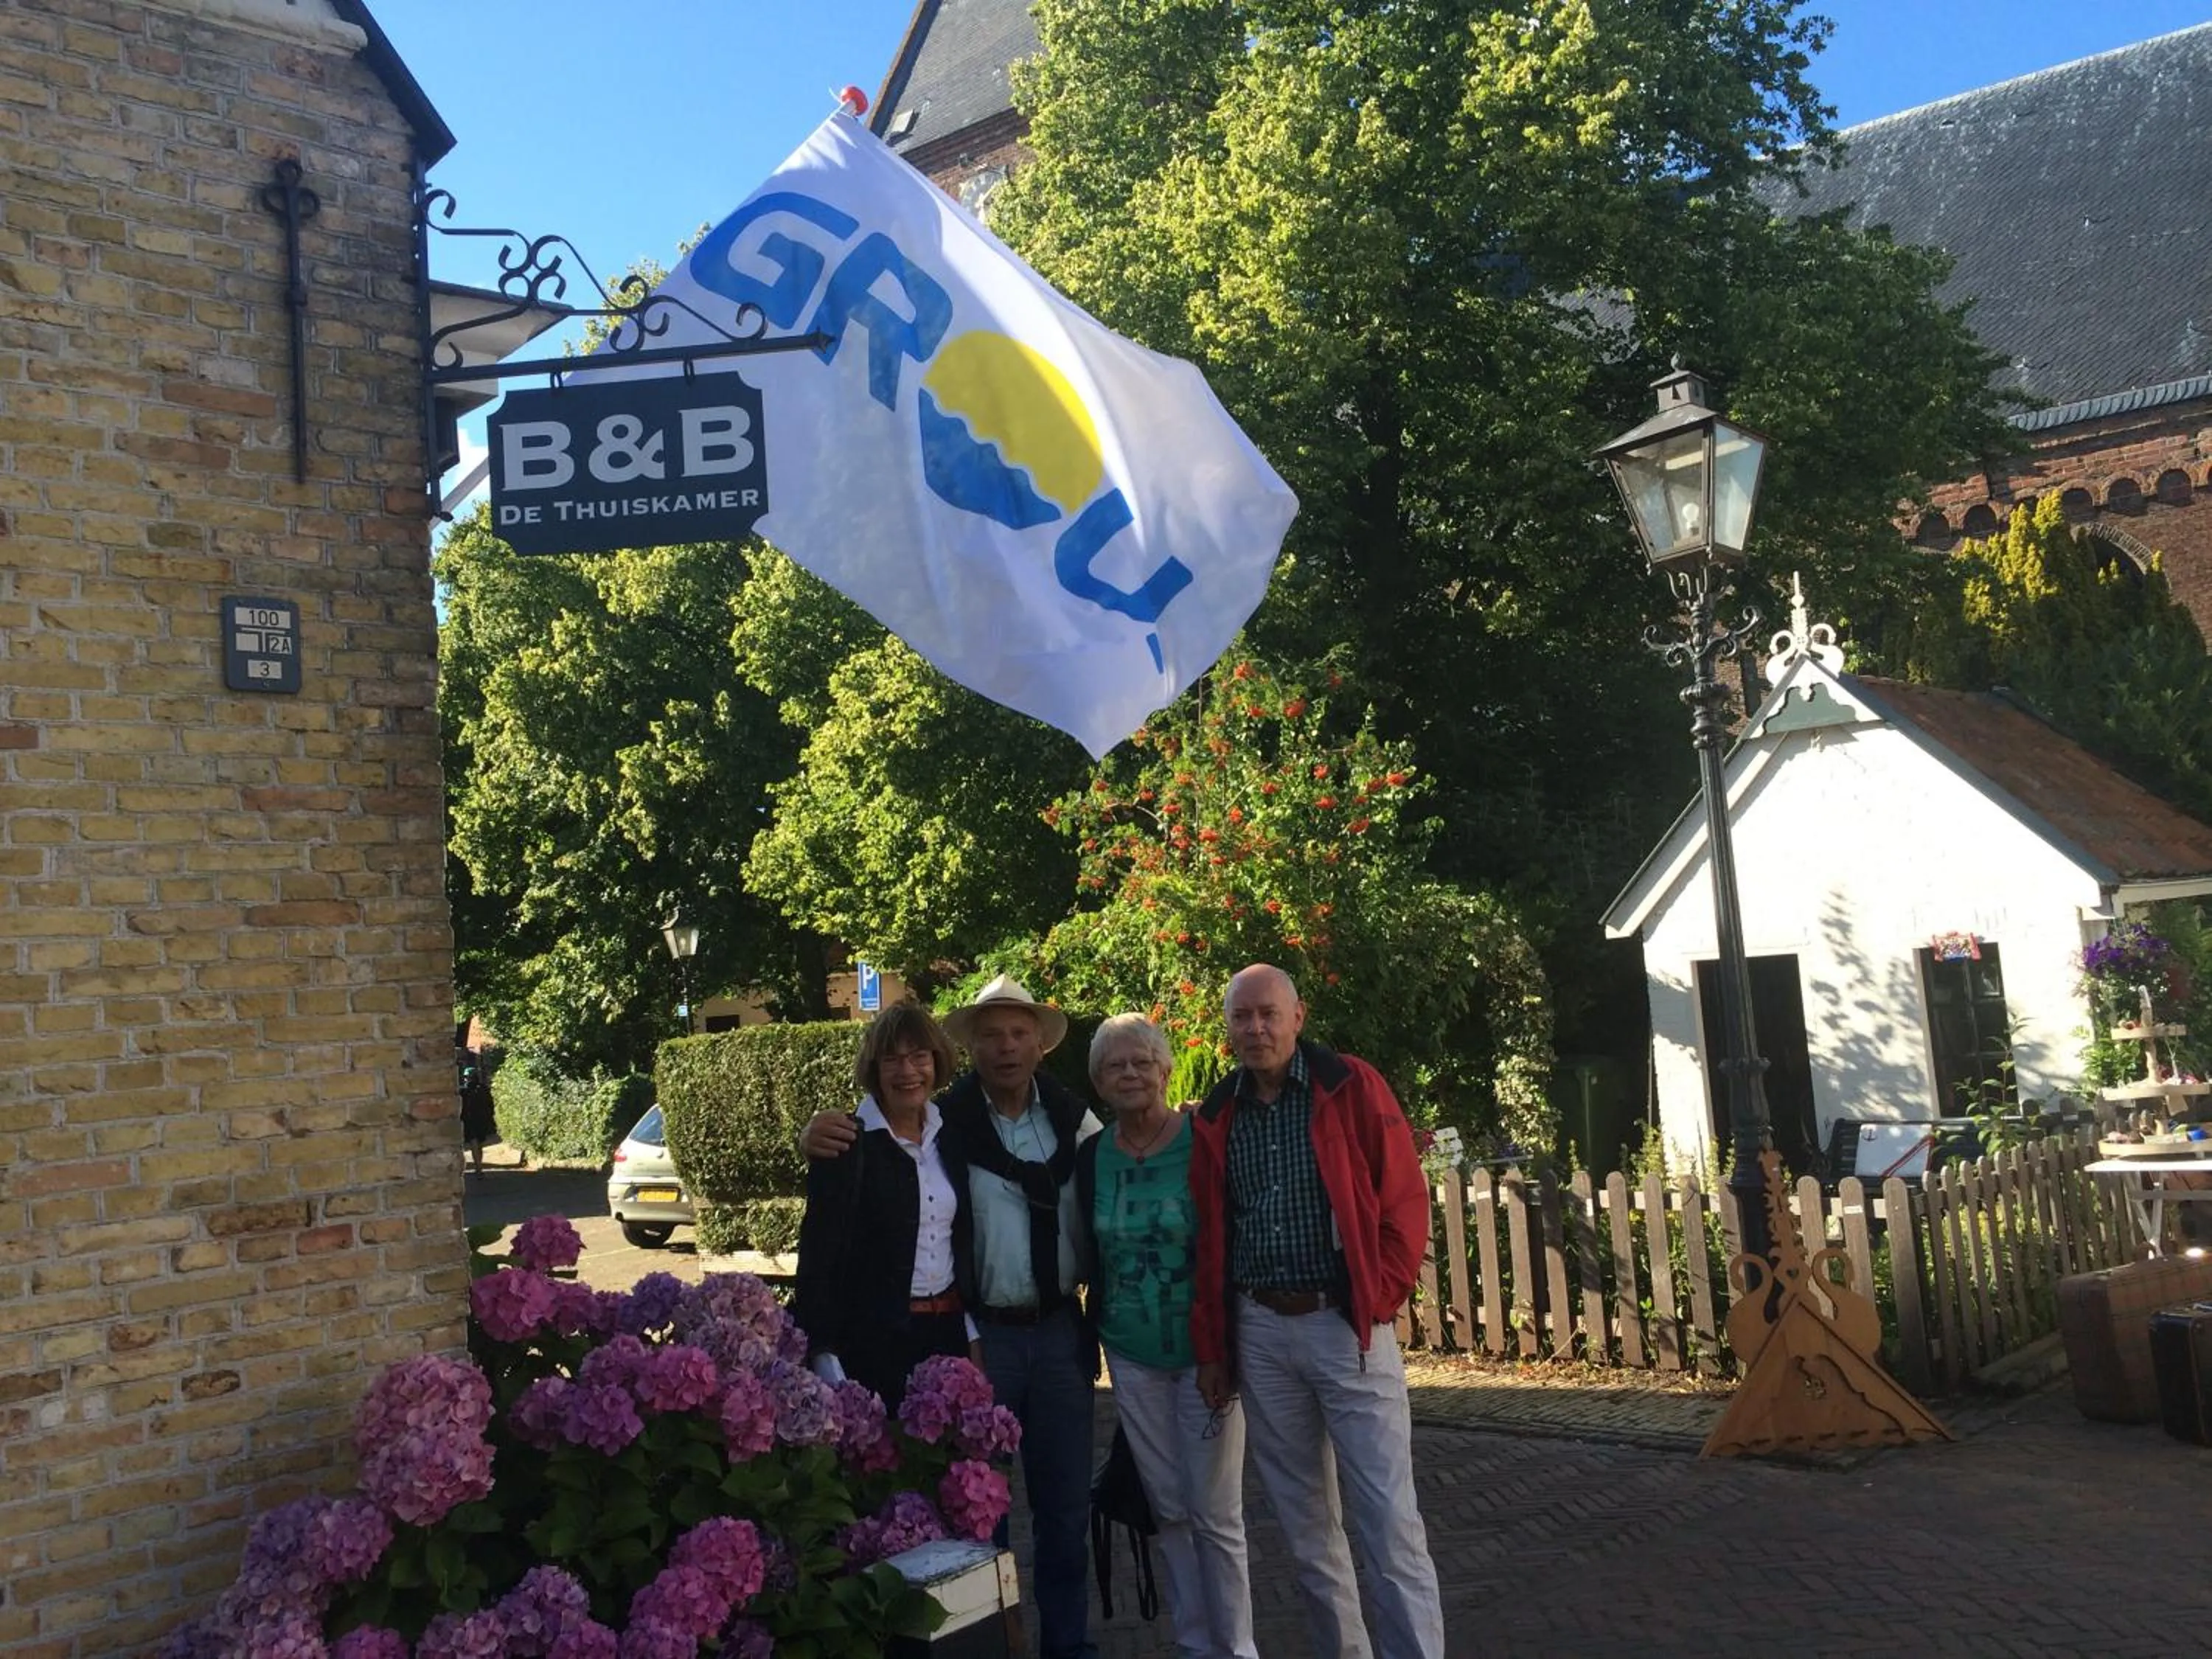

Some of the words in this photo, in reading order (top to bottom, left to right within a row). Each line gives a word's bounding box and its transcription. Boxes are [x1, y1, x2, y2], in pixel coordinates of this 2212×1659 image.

[499, 405, 755, 492] B&B
[499, 504, 542, 526] DE
[554, 488, 760, 521] THUISKAMER
[249, 610, 279, 626] 100
[271, 636, 291, 653] 2A
[260, 661, 270, 677] 3
[862, 963, 874, 990] P
